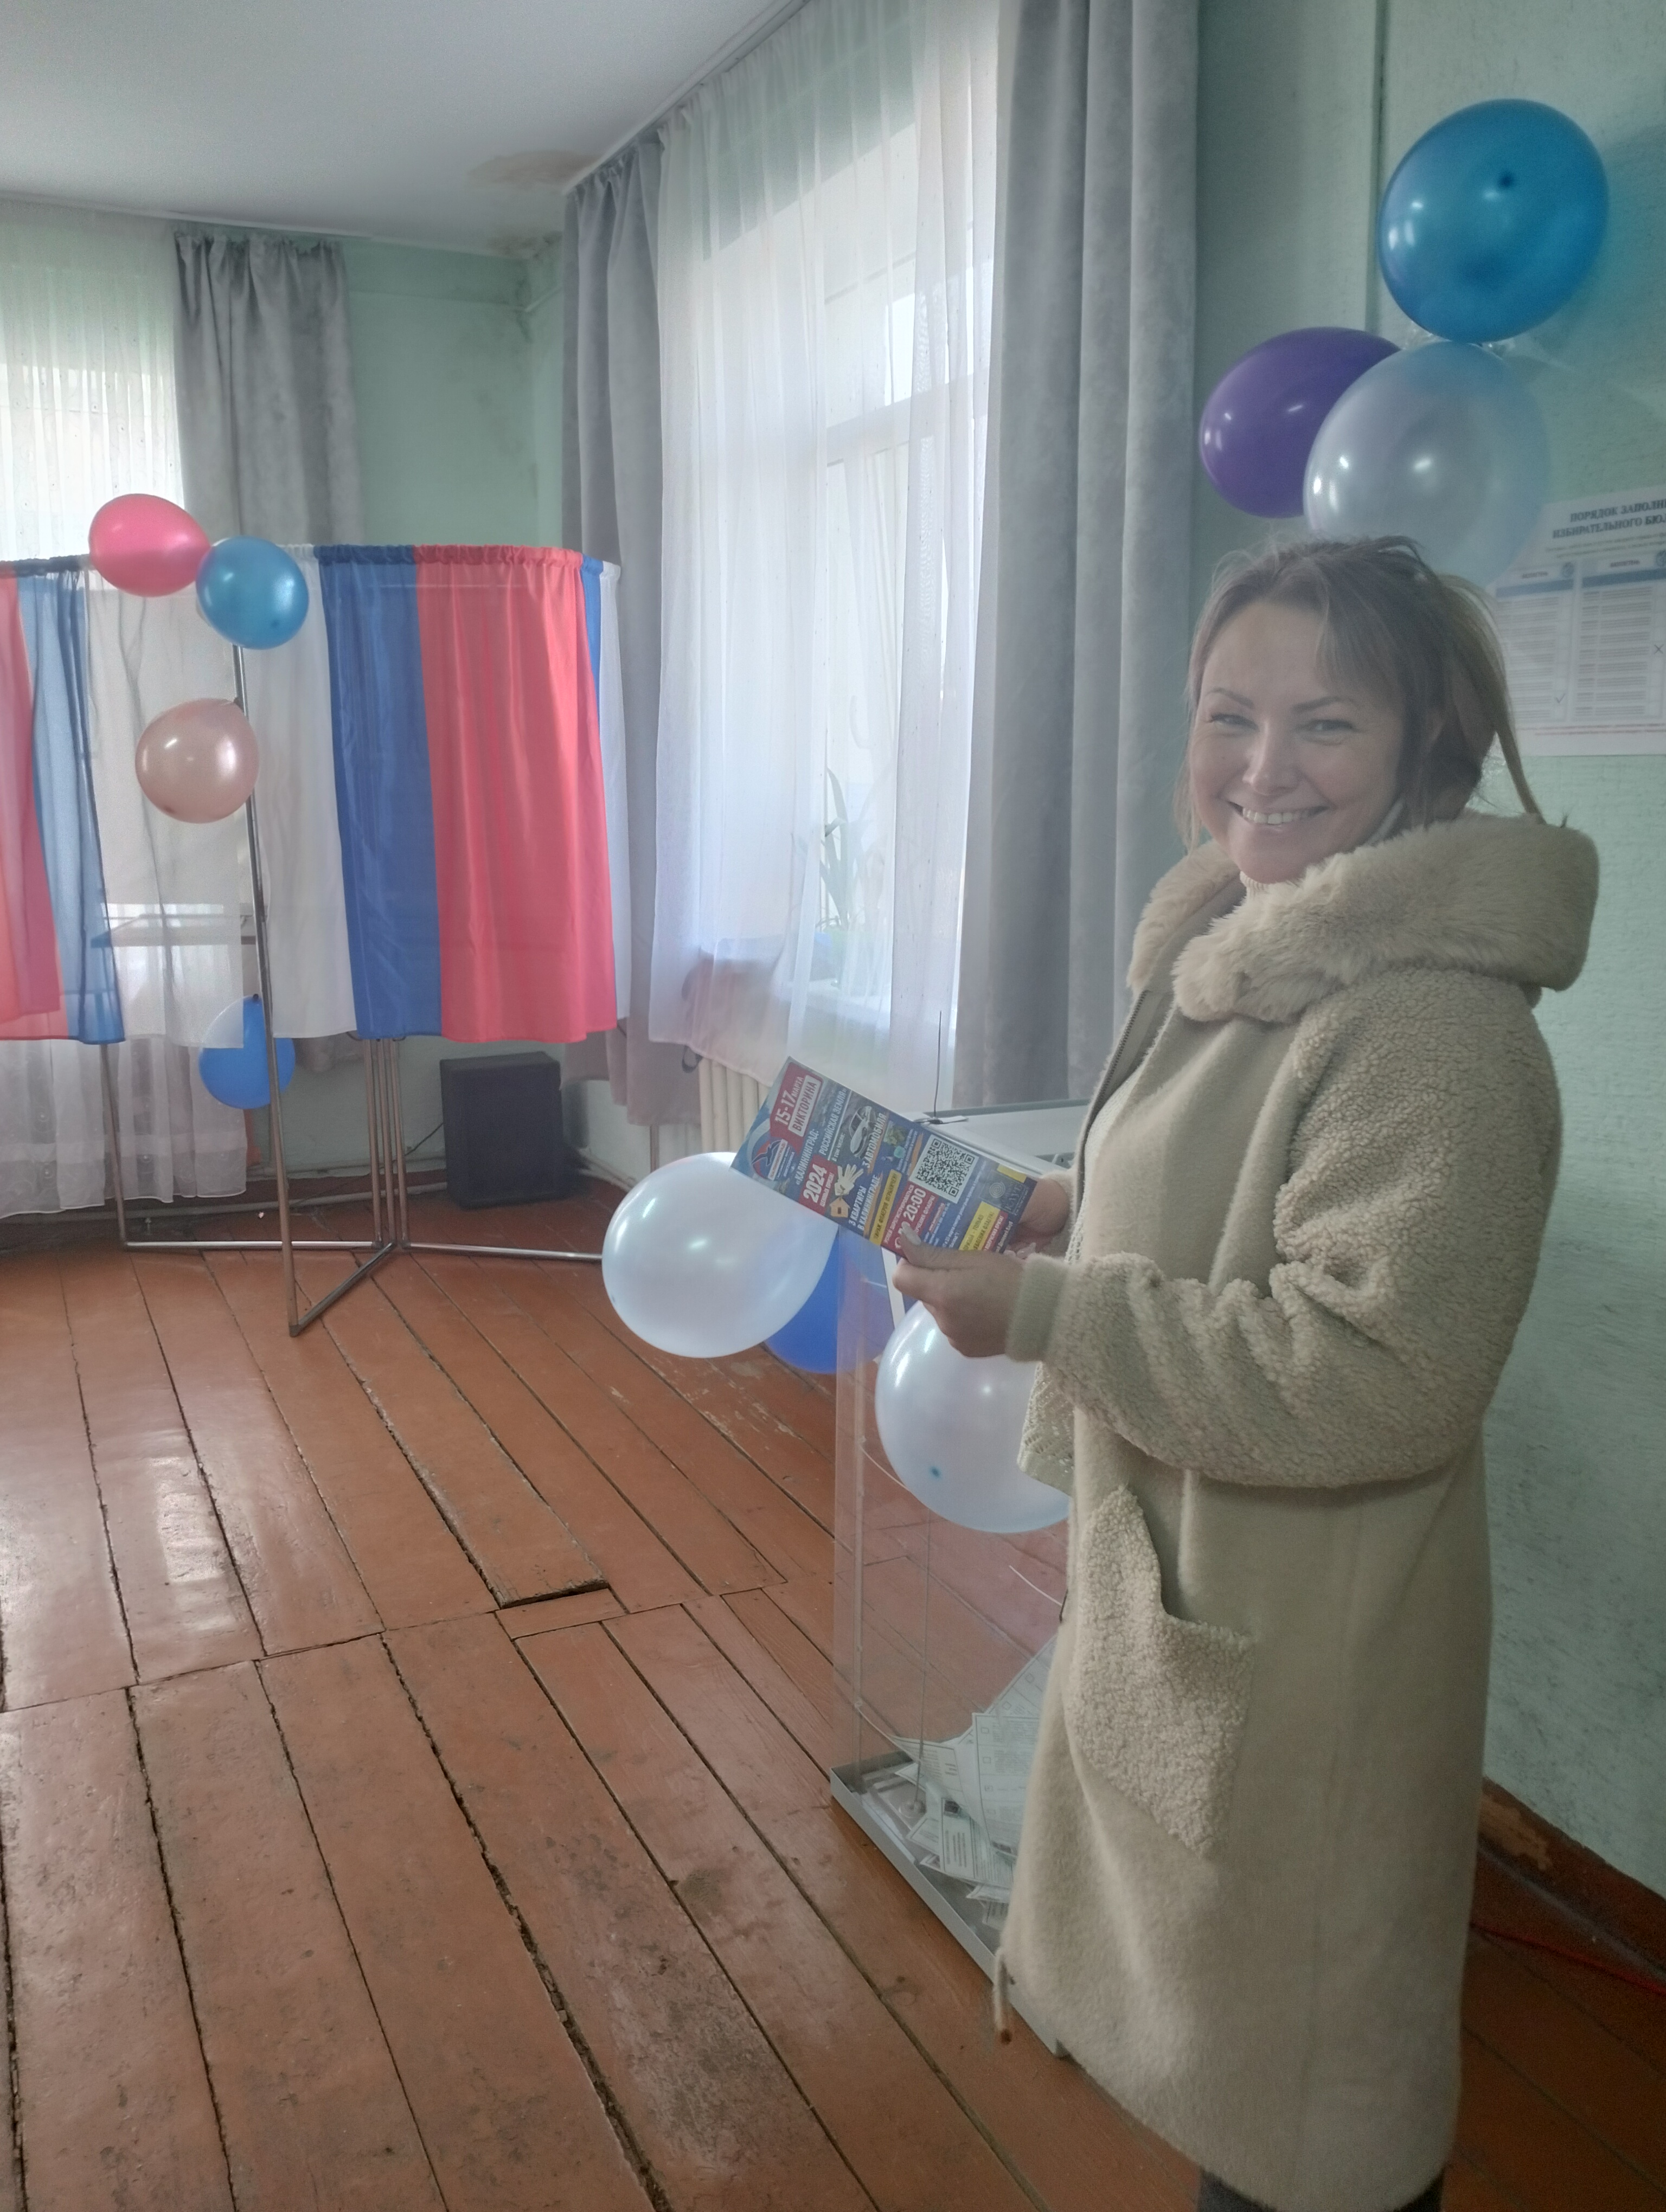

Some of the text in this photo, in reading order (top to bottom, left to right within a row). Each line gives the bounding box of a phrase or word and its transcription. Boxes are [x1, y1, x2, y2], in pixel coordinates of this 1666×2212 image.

[1553, 517, 1642, 538] ИЗБИРАТЕЛЬНОГО
[1571, 499, 1666, 522] ПОРЯДОК ЗАПОЛН
[776, 1076, 803, 1124] 15-17 МАРТА
[793, 1082, 816, 1130] ВИКТОРИНА
[819, 1089, 846, 1155] РОССИЙСКАЯ ЗЕМЛЯ»
[864, 1113, 885, 1161] АВТОМОБИЛЯ
[795, 1129, 818, 1185] «КАЛИНИНГРАД:
[803, 1164, 827, 1203] 2024
[819, 1188, 829, 1206] ЦЕННЫХ
[860, 1175, 879, 1224] КАЛИНИНГРАДЕ
[850, 1186, 866, 1220] КВАРТИРЫ
[879, 1201, 888, 1223] ФЛАЕРОВ
[884, 1229, 892, 1243] УСПЕЙ
[890, 1185, 913, 1229] ЗАРЕГИСТРИРОВАТЬСЯ
[902, 1188, 926, 1221] 20:00
[914, 1196, 934, 1232] ЛУЧЕНИЯ ФЛАЕРА!
[963, 1233, 974, 1250] ПРИЗОВ
[972, 1214, 983, 1230] ТОЛЬКО
[973, 1211, 994, 1249] ЯВЛЕНИИ ФЛАЕРА!
[985, 1229, 997, 1249] ПОЛУЧЕНИЯ
[995, 1216, 1004, 1229] ПРИЗА!
